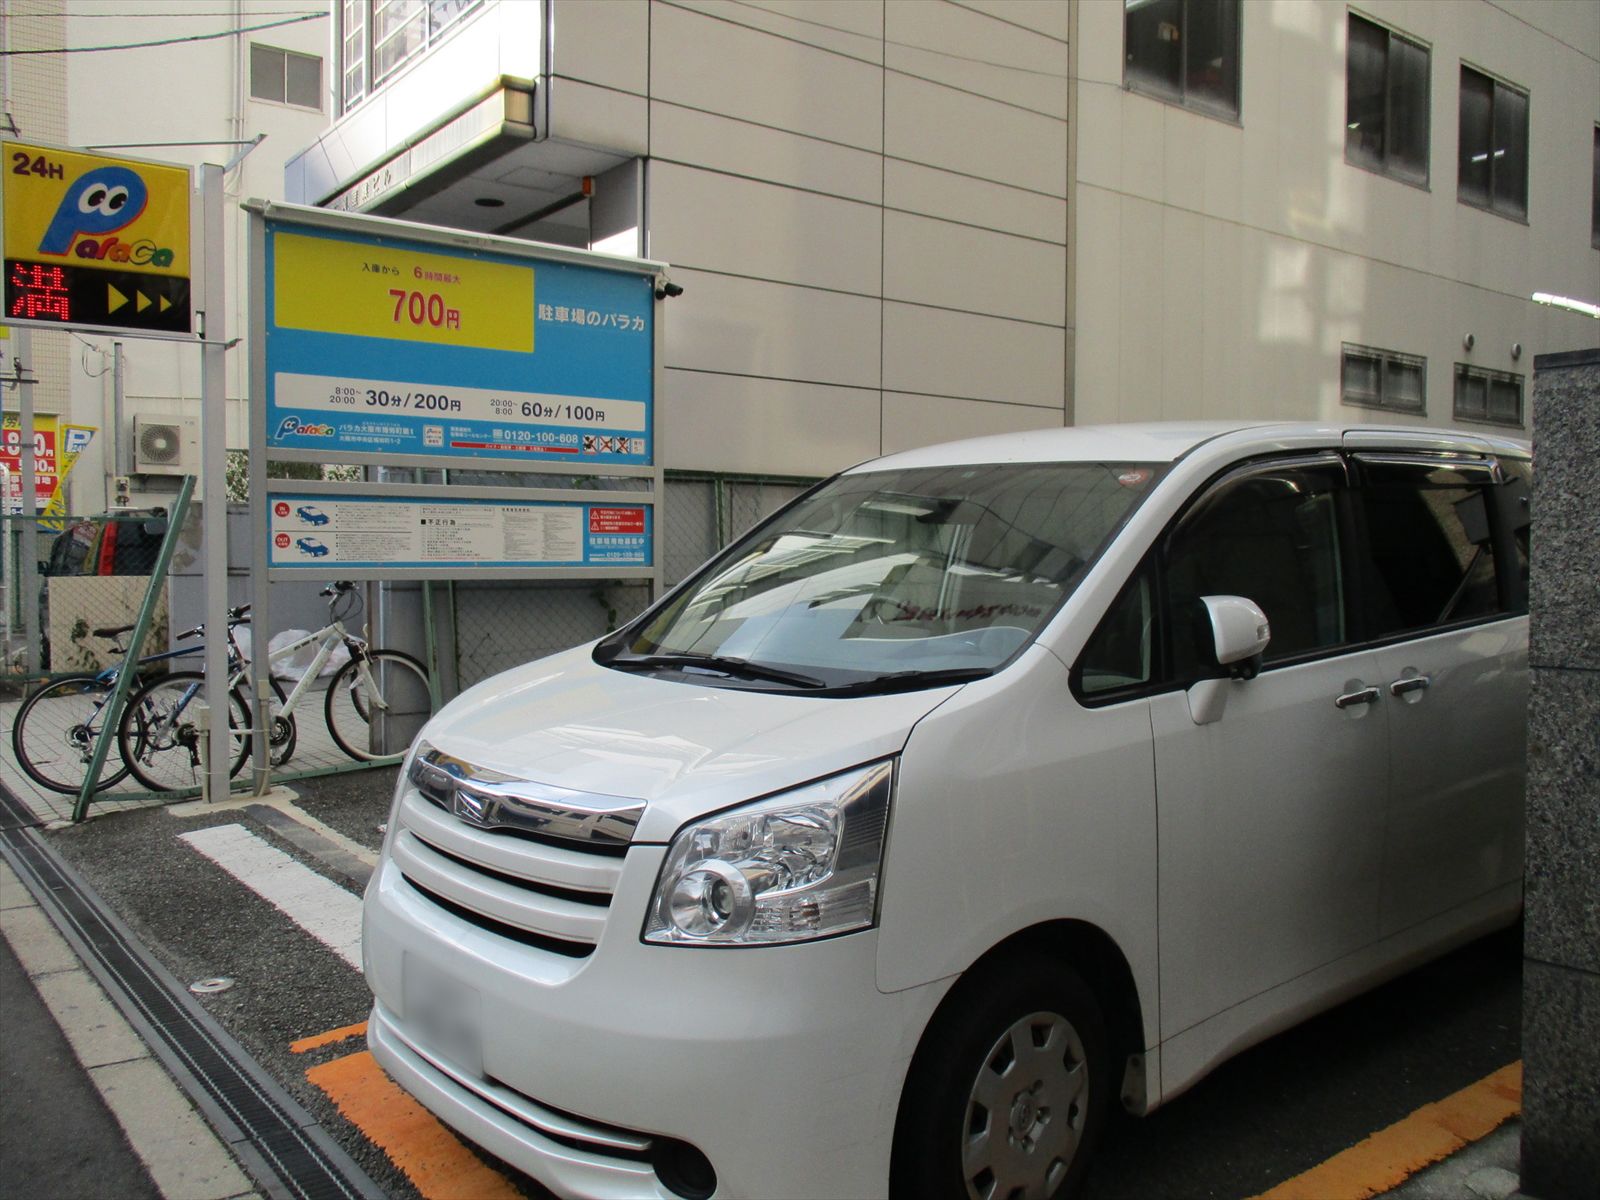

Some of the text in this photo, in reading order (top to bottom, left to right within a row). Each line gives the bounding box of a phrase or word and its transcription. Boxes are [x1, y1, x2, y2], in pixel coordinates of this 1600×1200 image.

[12, 152, 64, 180] 24H
[361, 262, 399, 275] 入庫から
[12, 263, 69, 320] 満
[389, 288, 461, 329] 700円
[538, 303, 645, 332] 駐車場のパラカ
[330, 395, 355, 405] 20:00
[495, 407, 513, 415] 8:00
